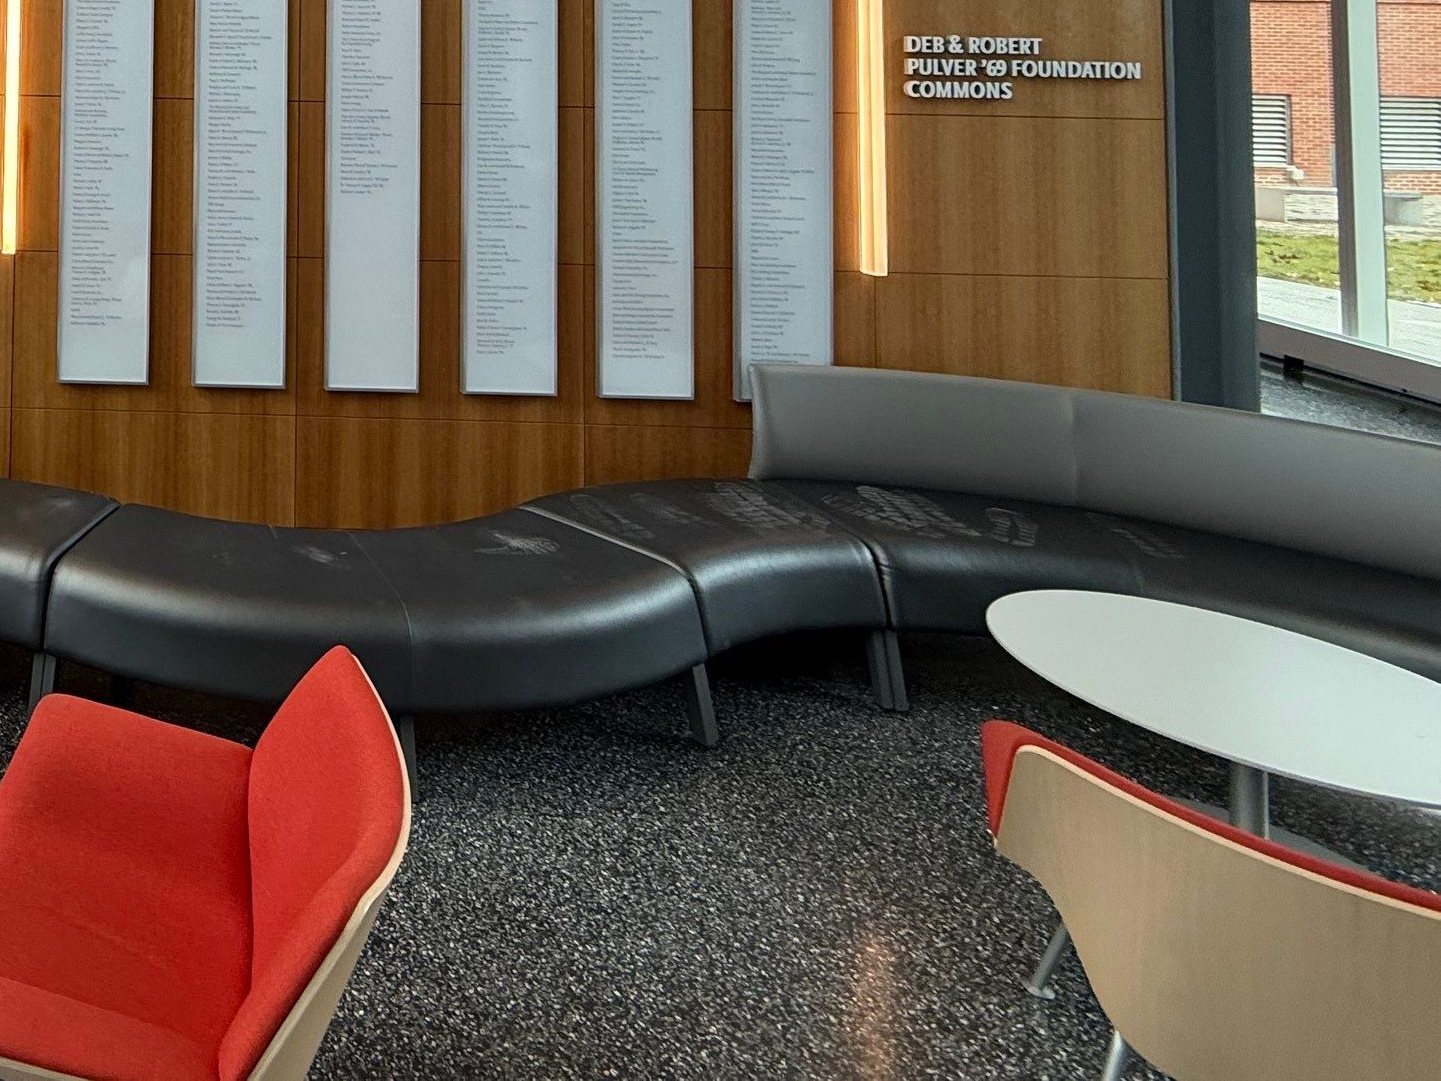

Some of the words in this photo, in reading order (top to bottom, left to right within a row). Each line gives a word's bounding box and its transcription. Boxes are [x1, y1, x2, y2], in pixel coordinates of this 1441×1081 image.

[904, 35, 944, 53] DEB
[948, 34, 964, 54] &
[968, 36, 1042, 55] ROBERT
[904, 58, 978, 76] PULVER
[1011, 60, 1141, 79] FOUNDATION
[903, 80, 1014, 99] COMMONS
